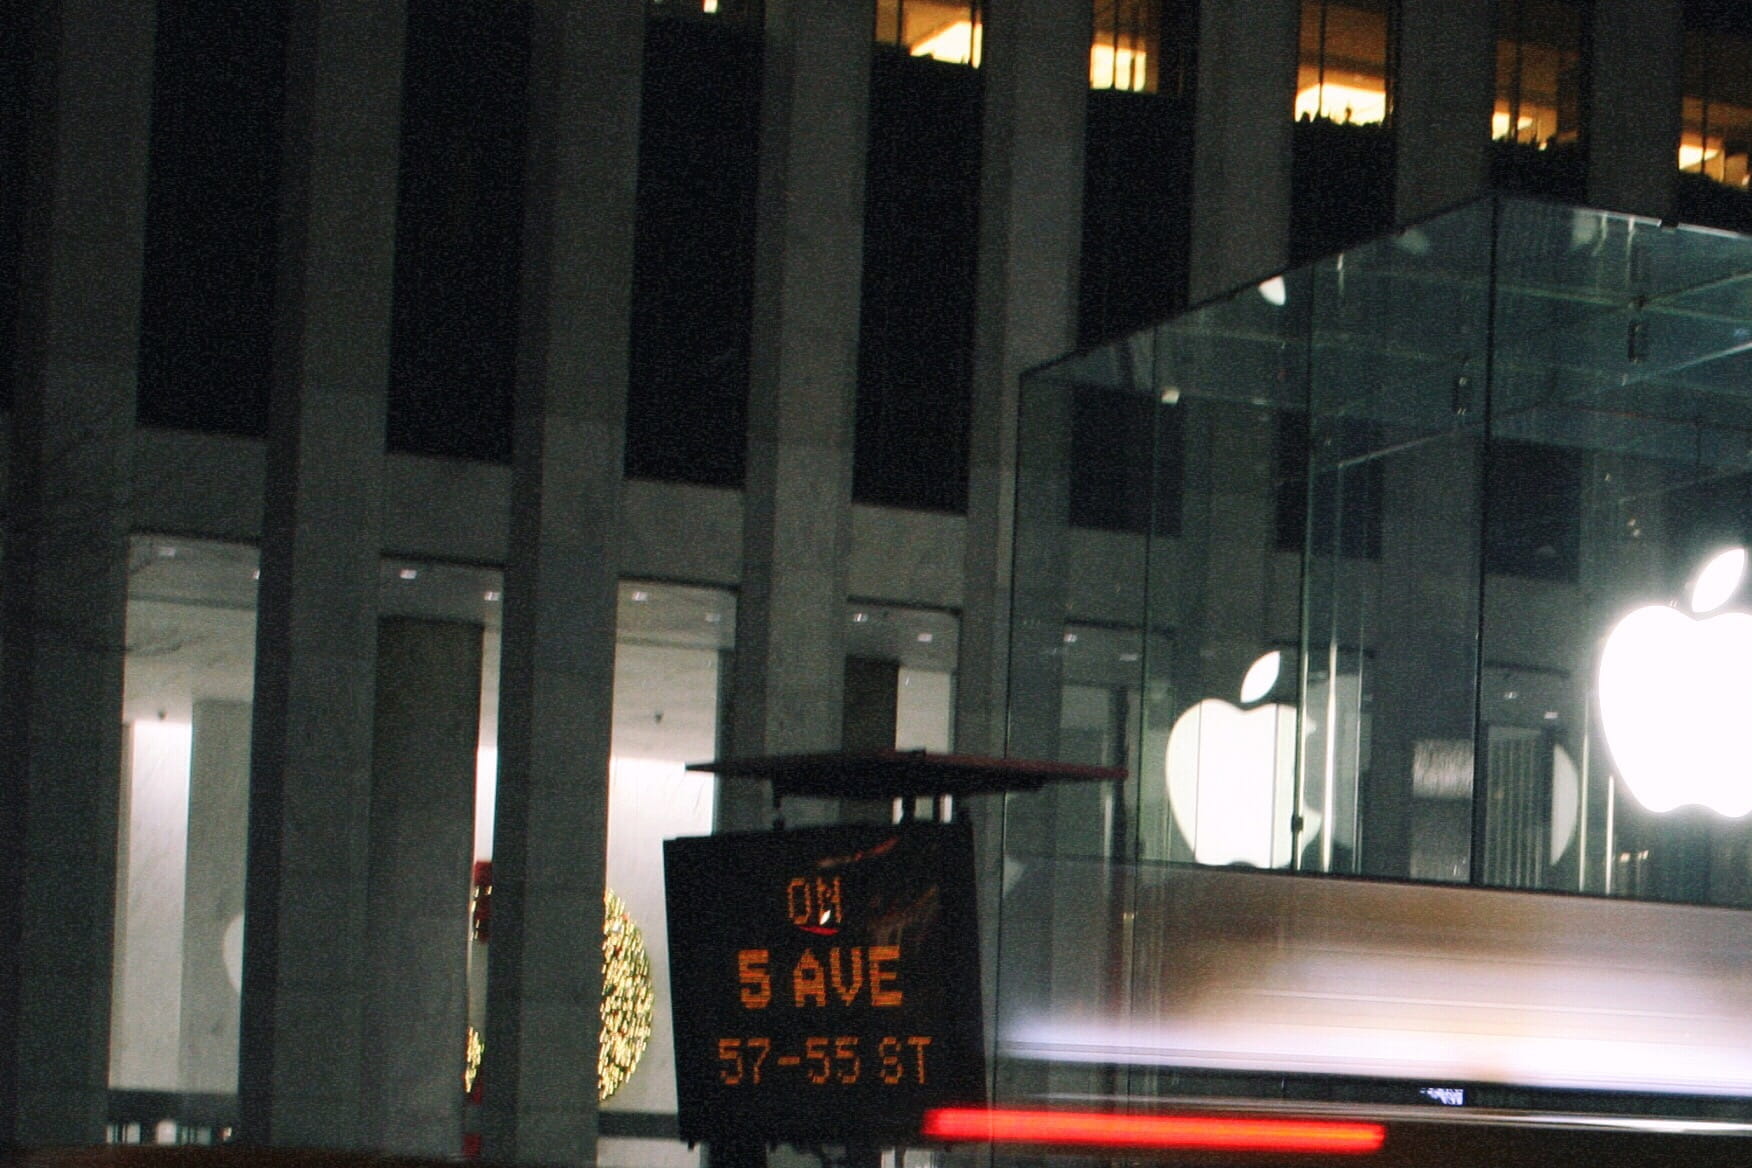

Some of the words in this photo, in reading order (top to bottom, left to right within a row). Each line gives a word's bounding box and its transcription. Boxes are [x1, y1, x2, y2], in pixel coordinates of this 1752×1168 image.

[787, 877, 843, 925] ON
[738, 949, 772, 1009] 5
[793, 946, 903, 1007] AVE
[718, 1037, 861, 1085] 57-55
[879, 1037, 933, 1085] ST
